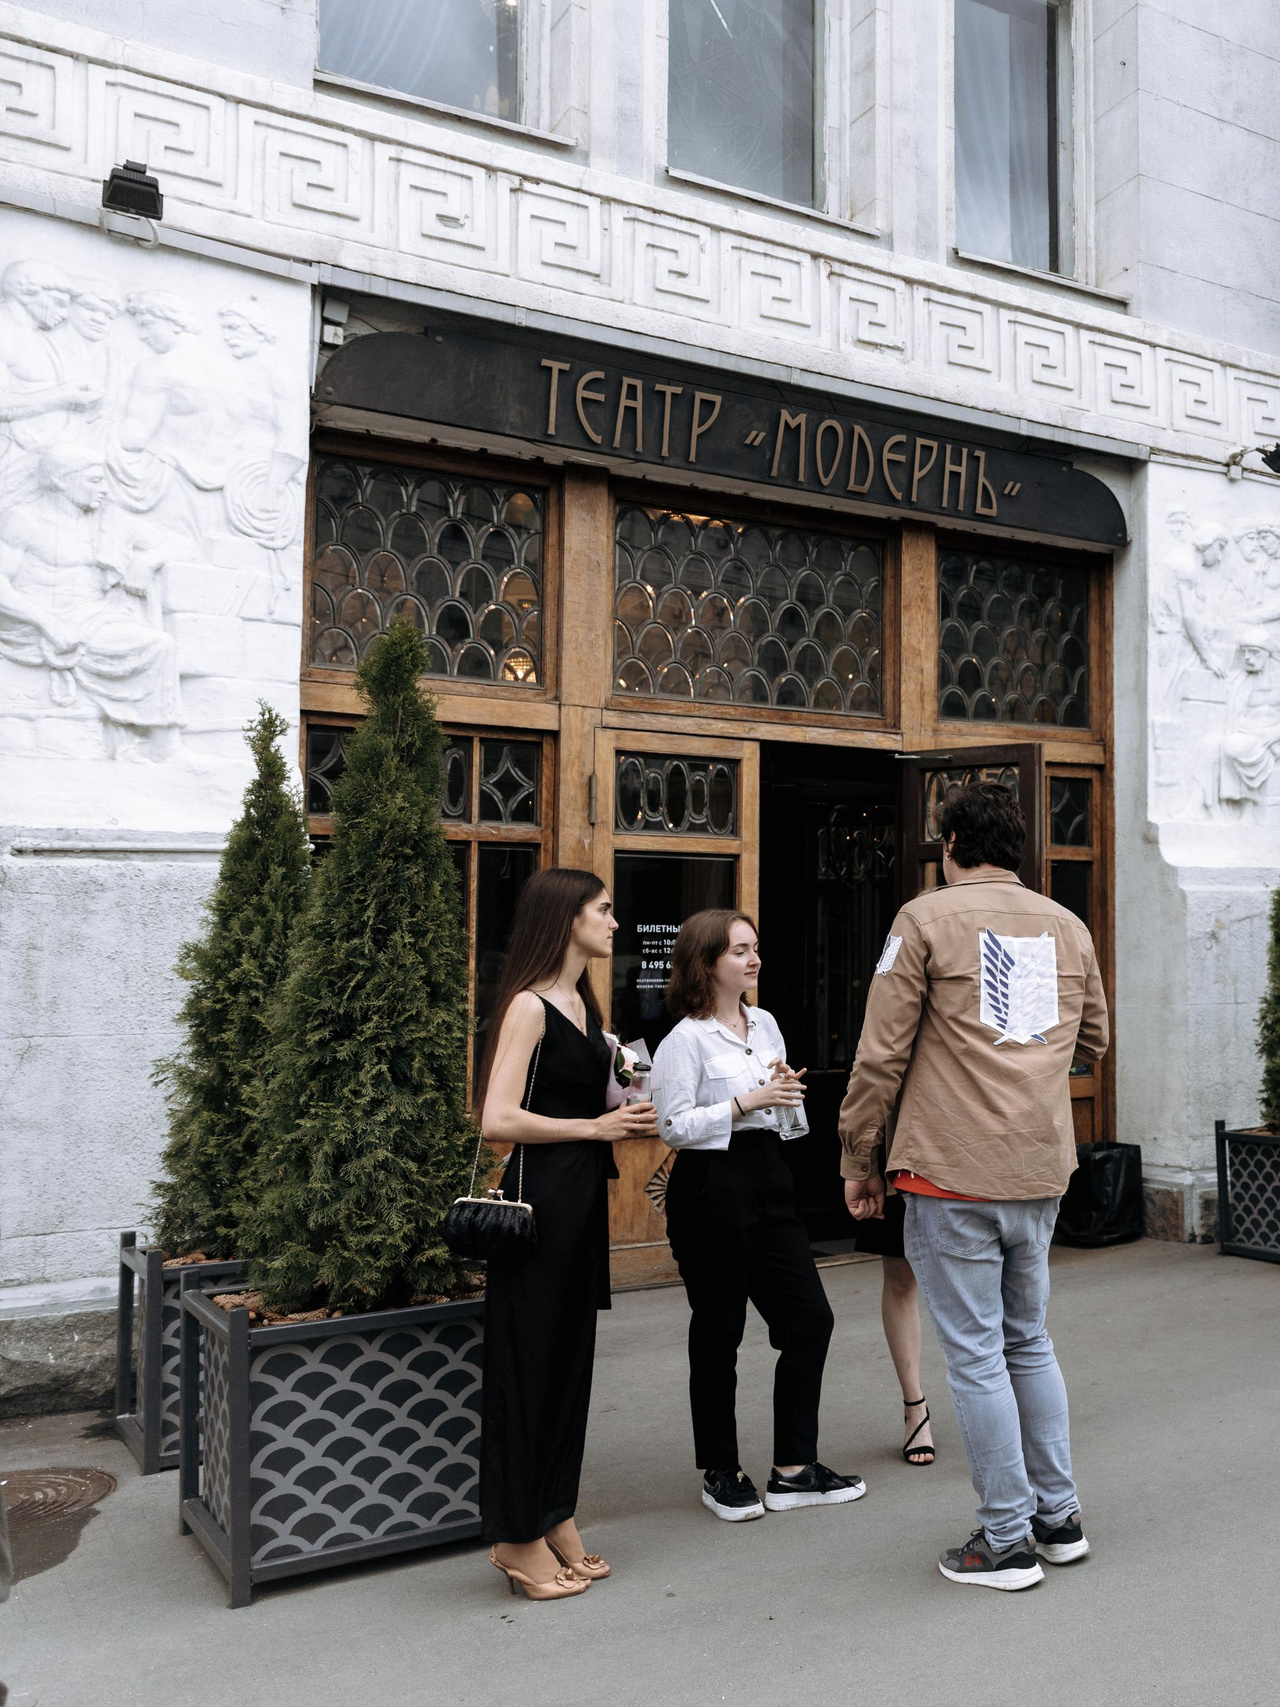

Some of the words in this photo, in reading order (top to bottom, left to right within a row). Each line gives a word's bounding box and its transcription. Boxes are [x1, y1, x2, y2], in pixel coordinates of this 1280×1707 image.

[540, 358, 723, 463] ТЕАТР
[636, 924, 684, 932] БИЛЕТНЫ
[641, 960, 647, 969] 8
[648, 960, 664, 969] 495
